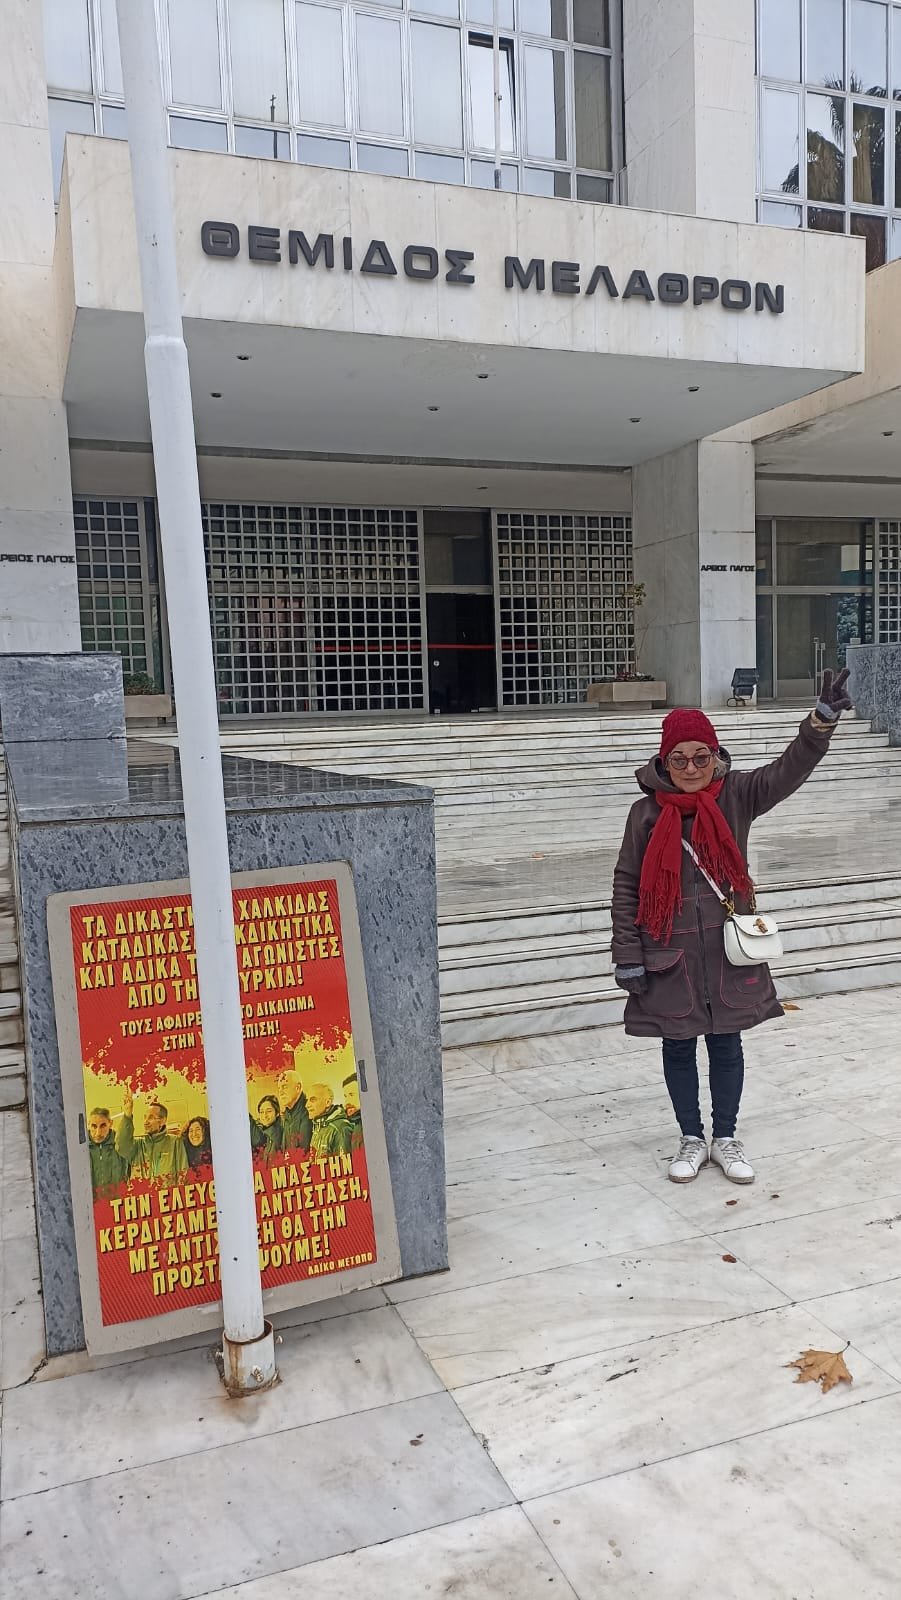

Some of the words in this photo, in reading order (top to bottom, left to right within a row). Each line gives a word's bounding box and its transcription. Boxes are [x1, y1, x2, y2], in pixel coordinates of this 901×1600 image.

[200, 220, 476, 285] ΘΕΜΙΔΟΣ
[504, 255, 785, 314] ΜΕΛΑΘΡΟΝ
[0, 554, 33, 563] ΡΕΙΟΣ
[36, 554, 76, 564] ΠΑΓΟΣ
[81, 930, 197, 964] ΚΑΤΑΔΙΚΑΣ
[234, 913, 335, 945] ΚΔΙΚΗΤΙΚΑ
[82, 915, 108, 938] ΤΑ
[115, 905, 195, 935] ΔΙΚΑΣΤ
[238, 891, 330, 921] ΧΑΛΚΙΔΑΣ
[79, 964, 115, 990] ΚΑΙ
[122, 956, 182, 984] ΑΔΙΚΑ
[242, 936, 341, 969] ΑΓΩΝΙΣΤΕΣ
[128, 982, 167, 1009] ΑΠΟ
[172, 978, 199, 1002] ΤΗ
[239, 965, 304, 993] ΥΡΚΙΑ!
[120, 1018, 153, 1037] ΤΟΥΣ
[156, 1011, 203, 1032] ΑΦΑΙΡΕ
[257, 995, 315, 1017] ΔΙΚΑΙΩΜΑ
[162, 1032, 197, 1051] ΣΤΗΝ
[110, 1193, 151, 1222] ΤΗΝ
[271, 1161, 312, 1190] ΜΑΣ
[316, 1153, 353, 1180] ΤΗΝ
[99, 1205, 218, 1253] ΚΕΡΔΙΣΑΜΕ
[261, 1176, 369, 1218] ΑΝΤΙΣΤΑΣΗ,
[128, 1245, 160, 1274] ΜΕ
[281, 1214, 305, 1239] ΘΑ
[310, 1205, 347, 1233] ΤΗΝ
[338, 1252, 373, 1268] ΜΕΤΩΠΟ
